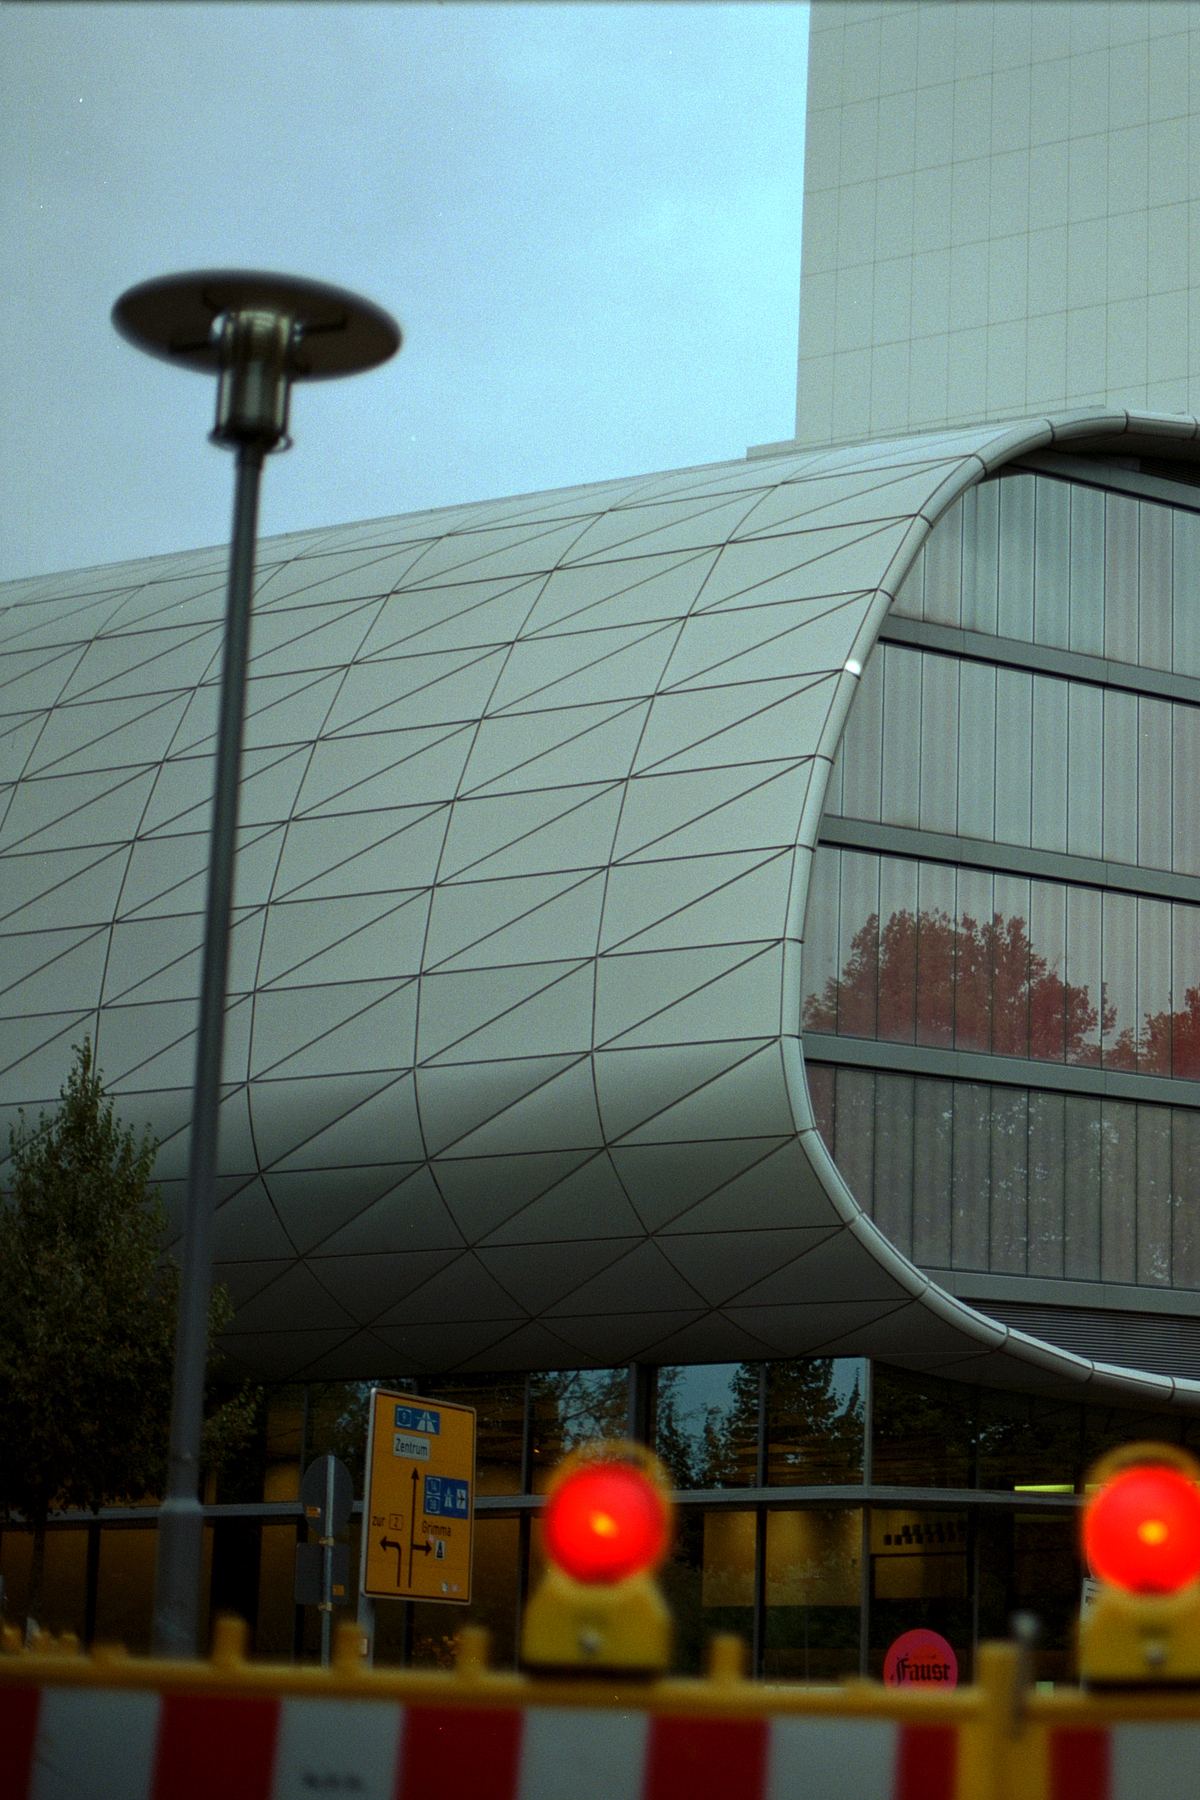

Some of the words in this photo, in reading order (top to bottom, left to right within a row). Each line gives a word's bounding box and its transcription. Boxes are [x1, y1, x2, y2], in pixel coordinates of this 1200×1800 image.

[395, 1438, 428, 1456] Zentrum
[372, 1515, 386, 1527] zur
[421, 1520, 452, 1537] Grimma
[890, 1654, 951, 1687] Faust
